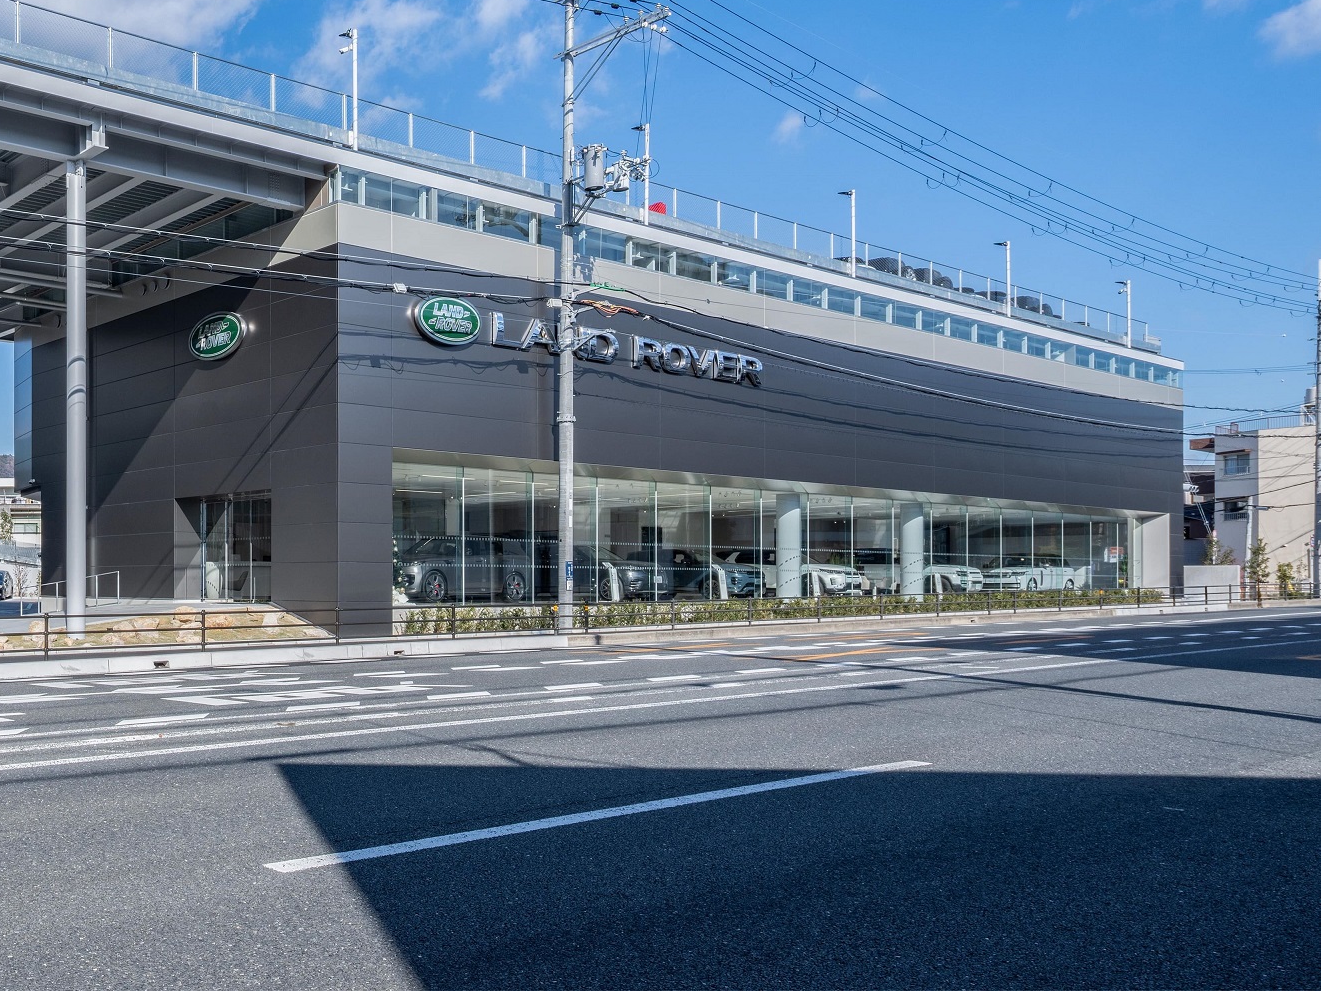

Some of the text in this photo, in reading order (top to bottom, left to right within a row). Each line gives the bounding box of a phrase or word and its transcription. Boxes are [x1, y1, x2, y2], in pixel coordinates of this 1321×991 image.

[433, 302, 464, 318] LAND
[198, 320, 224, 339] LAND
[434, 316, 473, 334] ROVER
[200, 331, 232, 351] ROVER
[629, 333, 763, 386] ROVER
